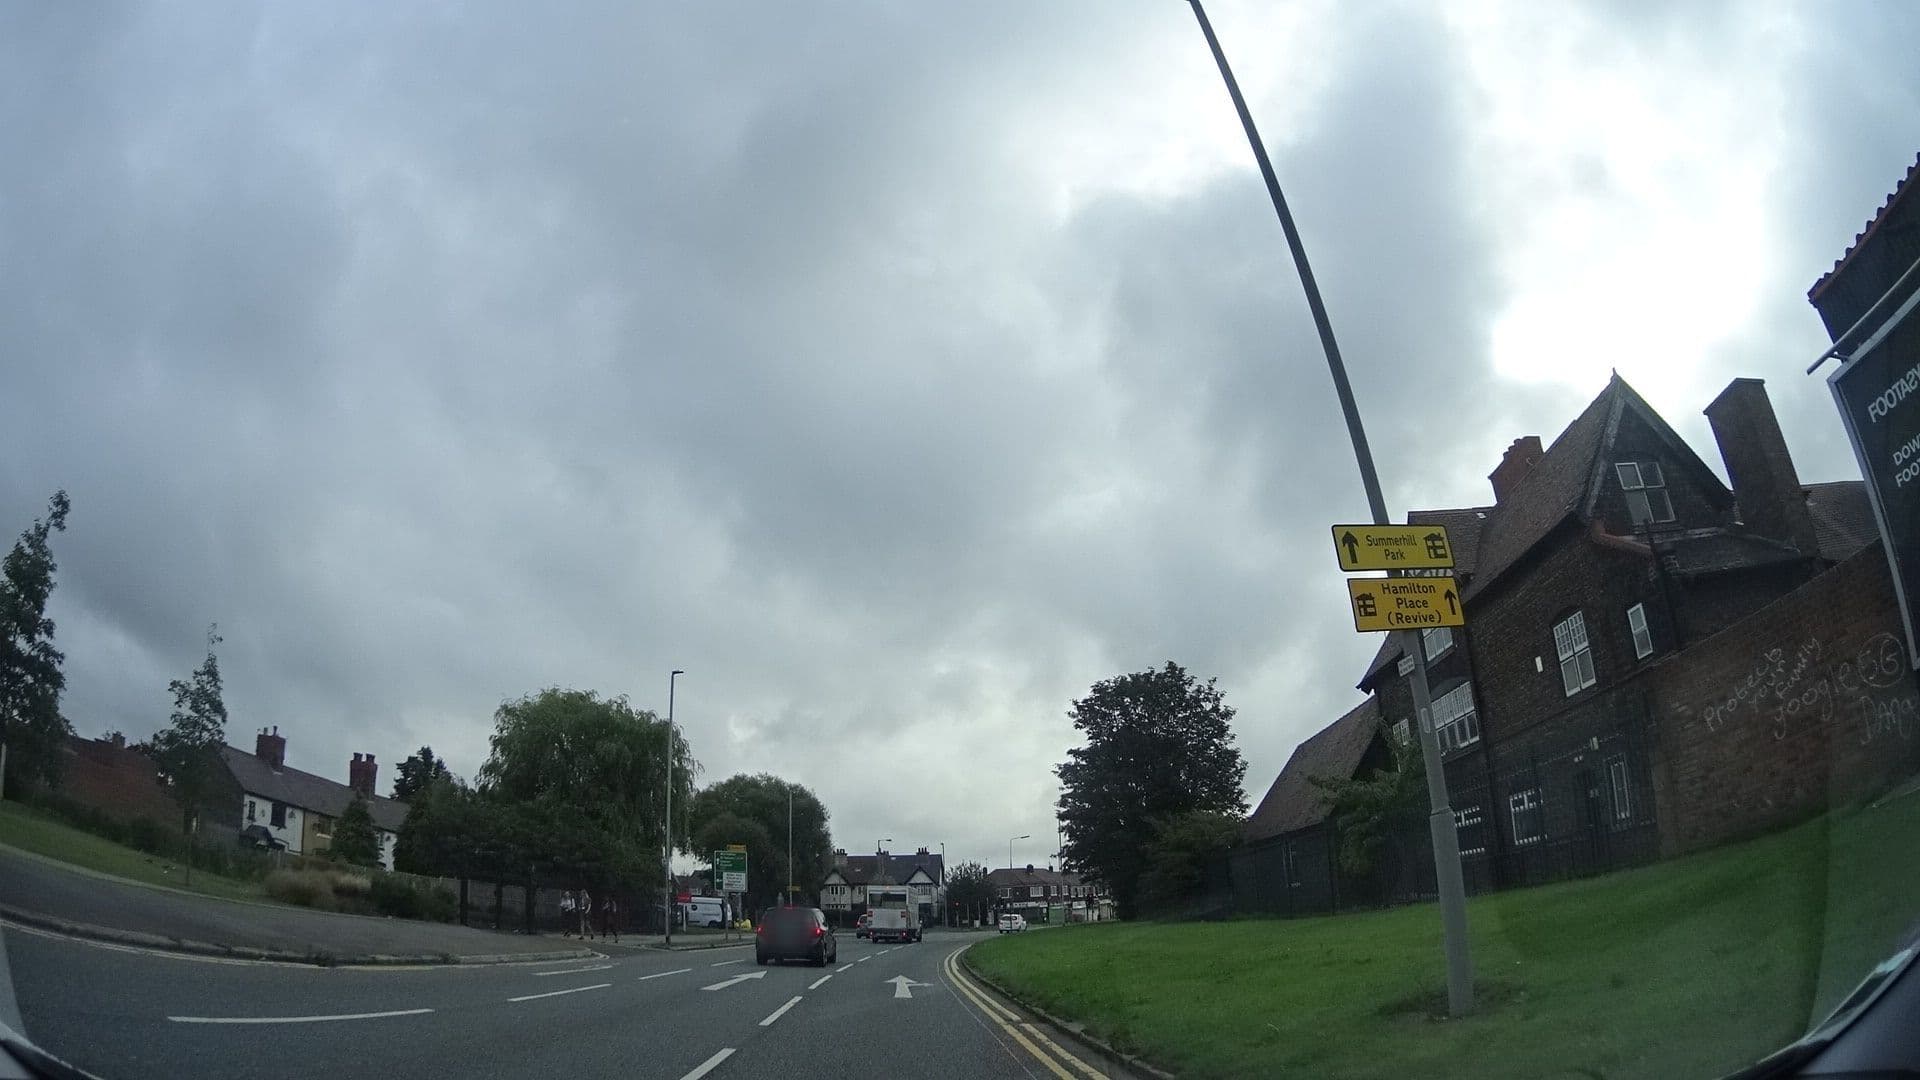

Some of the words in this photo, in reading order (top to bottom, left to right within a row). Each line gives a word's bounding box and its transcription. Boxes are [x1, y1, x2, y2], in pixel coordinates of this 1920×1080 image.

[1893, 433, 1920, 466] DOW
[1895, 458, 1920, 487] FOO
[1366, 534, 1418, 547] Summerhill
[1384, 549, 1406, 561] Park
[1381, 583, 1436, 596] Hamilton
[1396, 597, 1429, 609] Place
[1388, 610, 1442, 626] (Revive)
